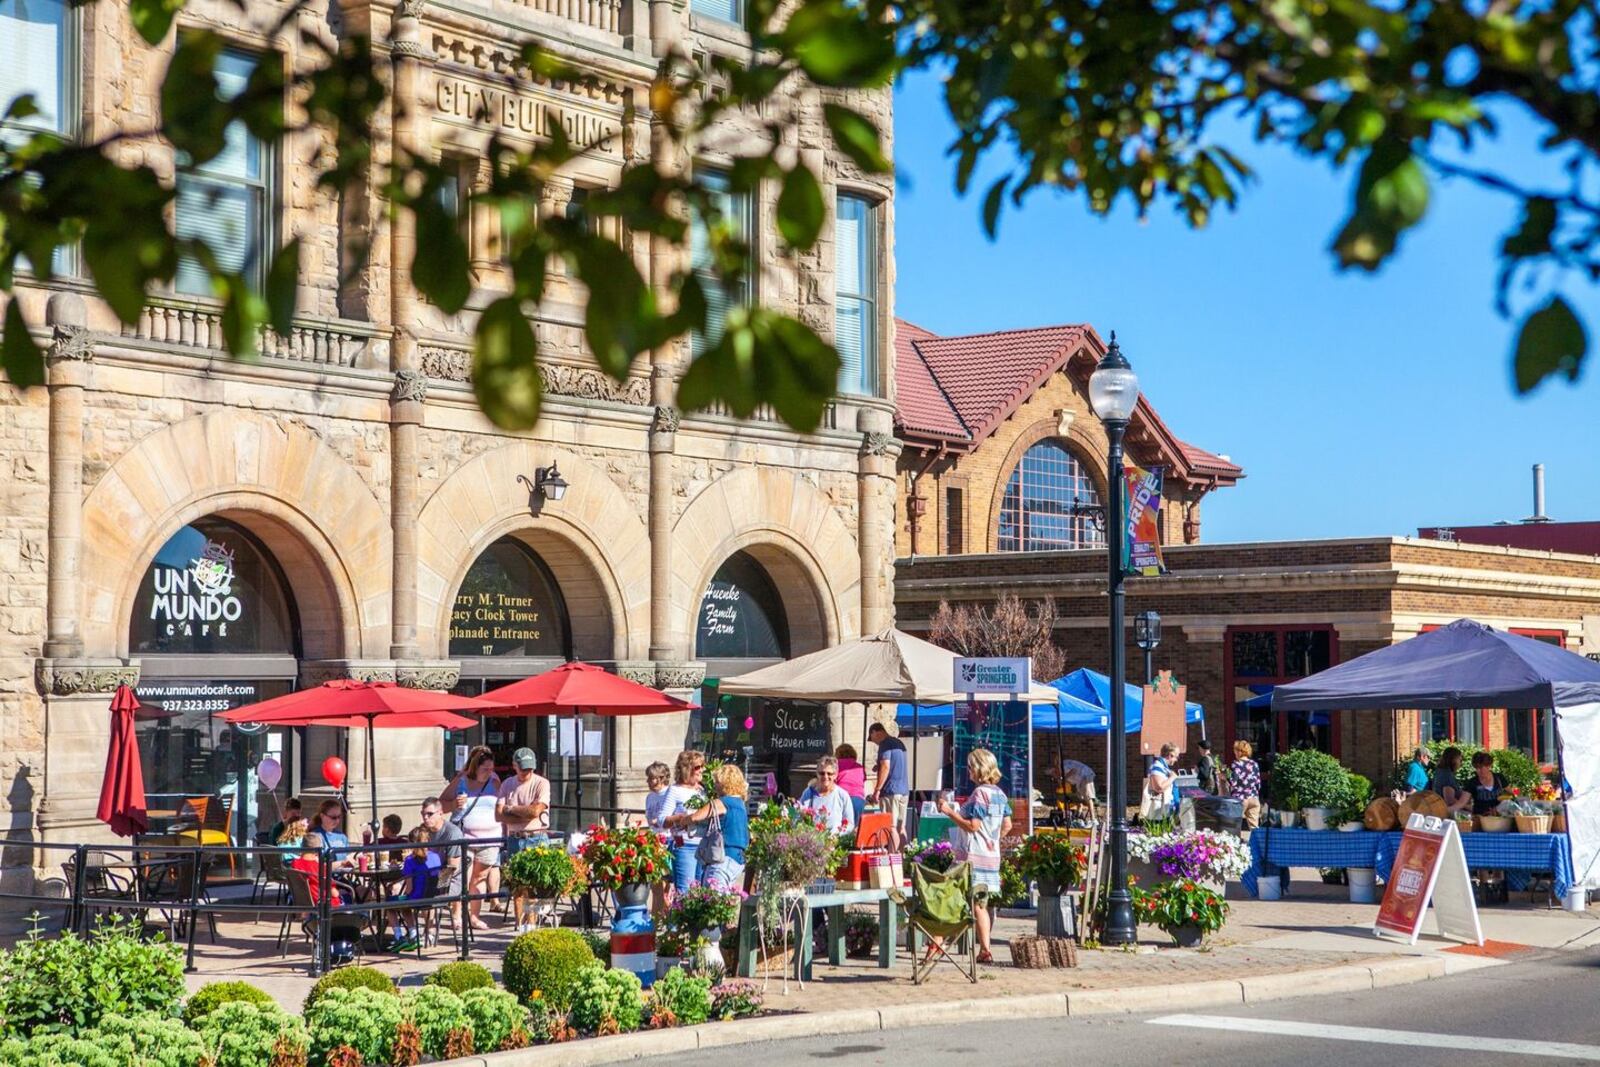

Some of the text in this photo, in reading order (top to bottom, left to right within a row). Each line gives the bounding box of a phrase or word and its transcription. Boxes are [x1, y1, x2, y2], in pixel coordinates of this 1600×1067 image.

[436, 78, 494, 124] CITY
[1127, 471, 1158, 538] PRIDE
[154, 568, 189, 595] UN
[150, 594, 242, 621] MUNDO
[479, 593, 494, 606] M.
[497, 594, 533, 607] Turner
[475, 608, 506, 621] Clock
[508, 609, 539, 622] Tower
[705, 603, 738, 623] Family
[166, 622, 227, 637] CAFÉ
[493, 627, 540, 640] Entrance
[701, 618, 735, 637] Farm
[977, 664, 1011, 673] Greater
[977, 673, 1017, 684] SPRINGFIELD
[136, 684, 255, 697] www.unmundocafe.com
[162, 699, 230, 712] 937.323.8355
[775, 708, 805, 731] Slice
[771, 733, 804, 749] Heaven
